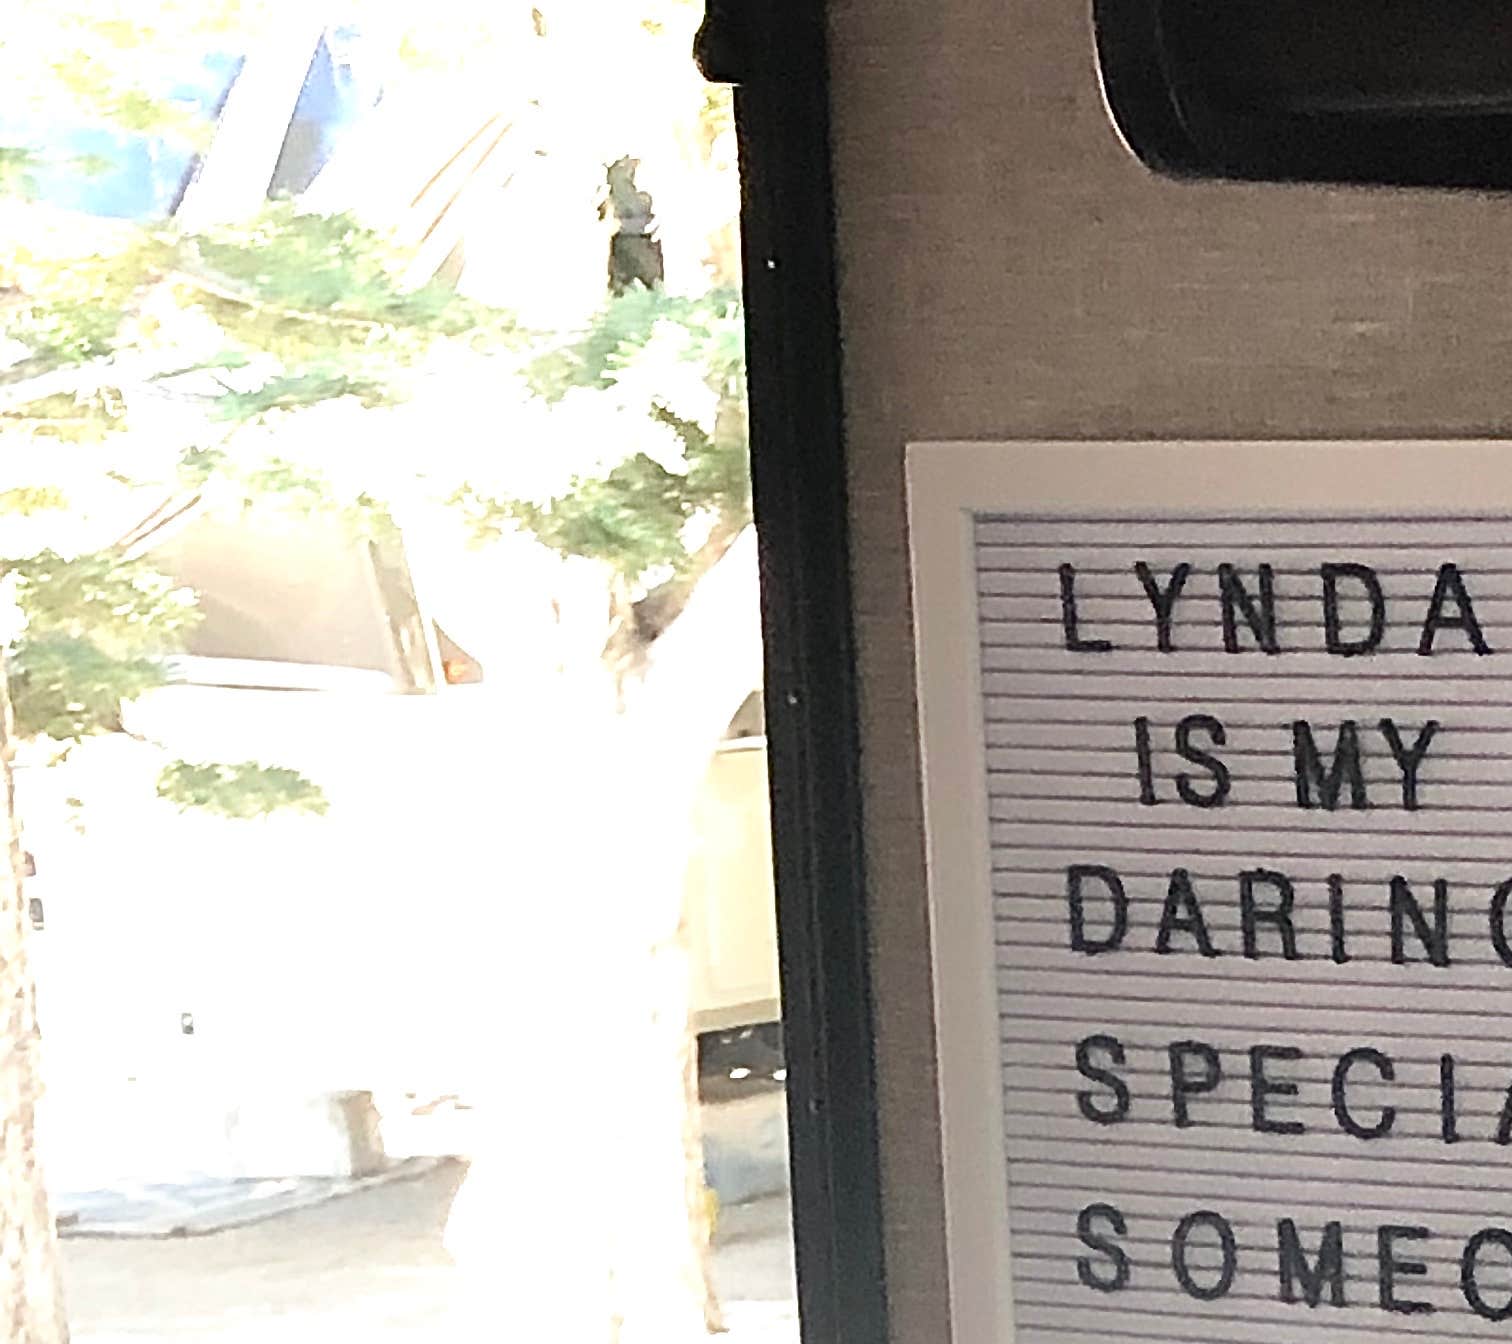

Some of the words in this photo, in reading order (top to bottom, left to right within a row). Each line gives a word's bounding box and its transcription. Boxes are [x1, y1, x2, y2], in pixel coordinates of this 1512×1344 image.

[1058, 562, 1493, 657] LYNDA
[1134, 714, 1230, 807] IS
[1292, 718, 1440, 810] MY
